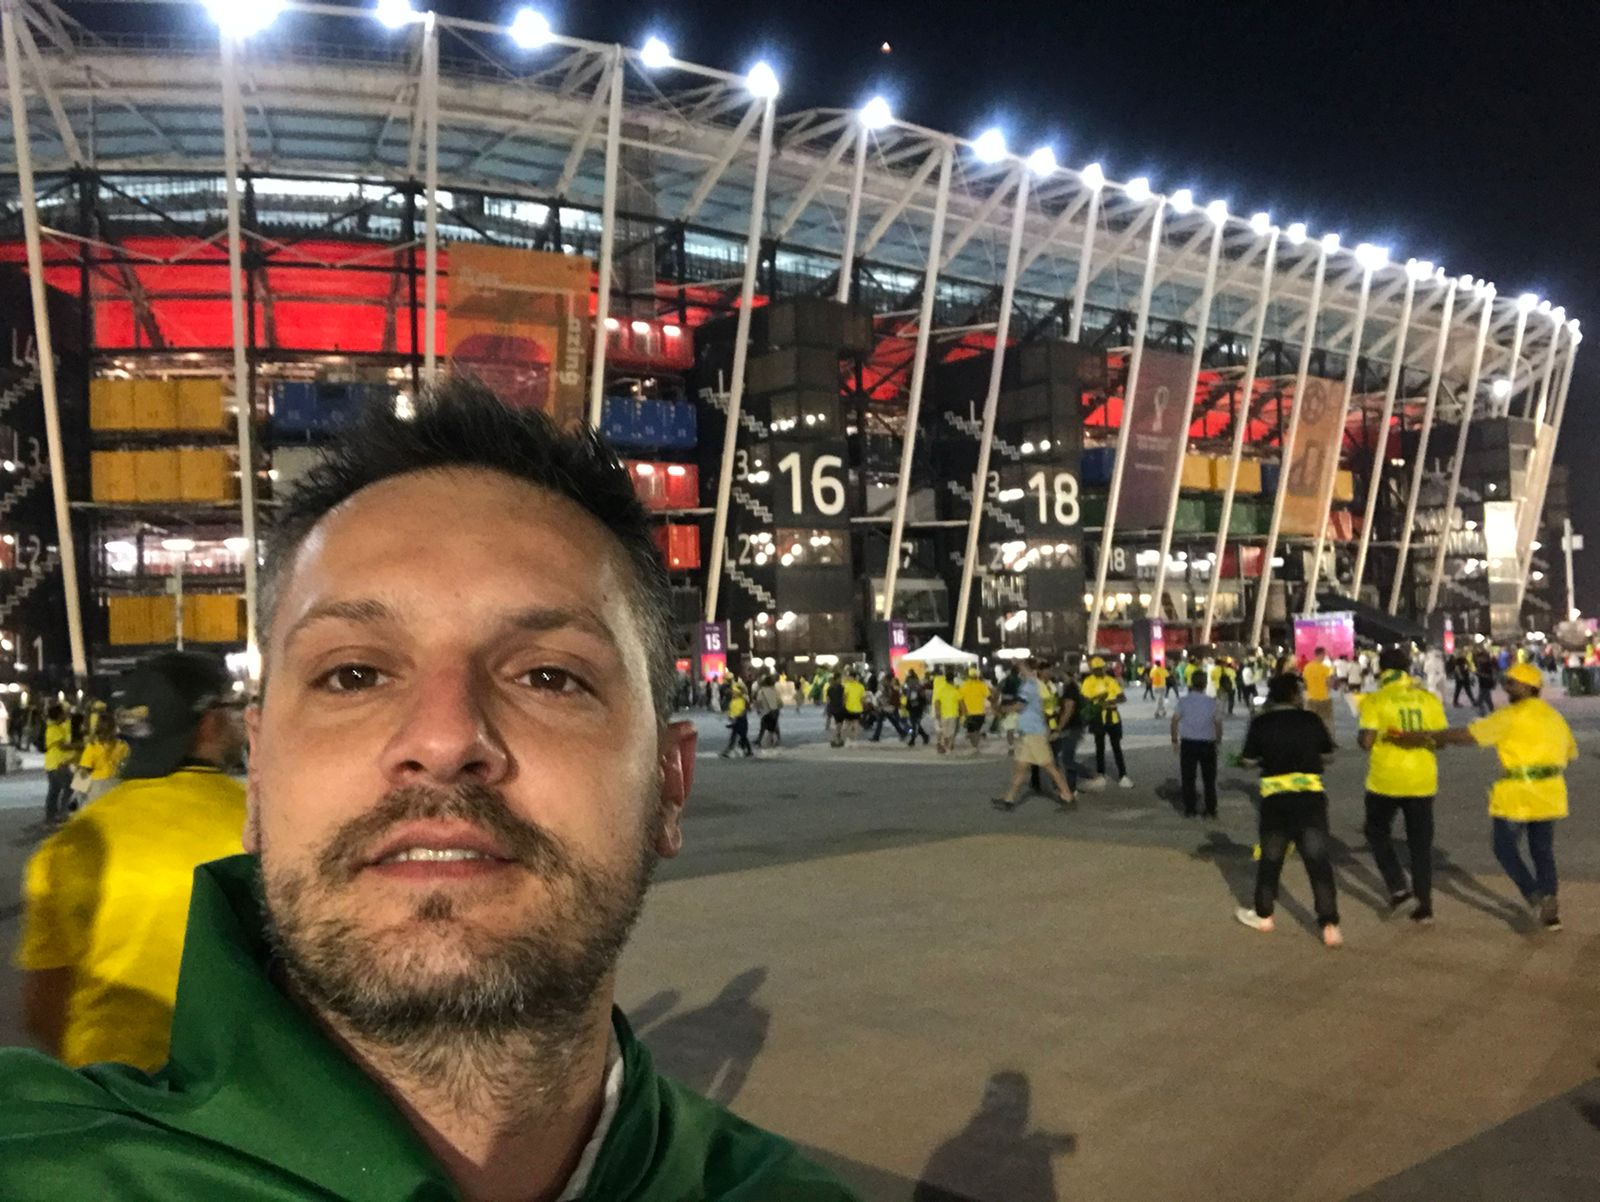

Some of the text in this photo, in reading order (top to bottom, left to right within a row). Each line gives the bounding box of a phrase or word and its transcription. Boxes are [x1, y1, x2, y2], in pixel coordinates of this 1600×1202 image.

[778, 452, 845, 515] 16
[1028, 471, 1080, 526] 18
[901, 542, 913, 569] 7
[705, 633, 721, 651] 15
